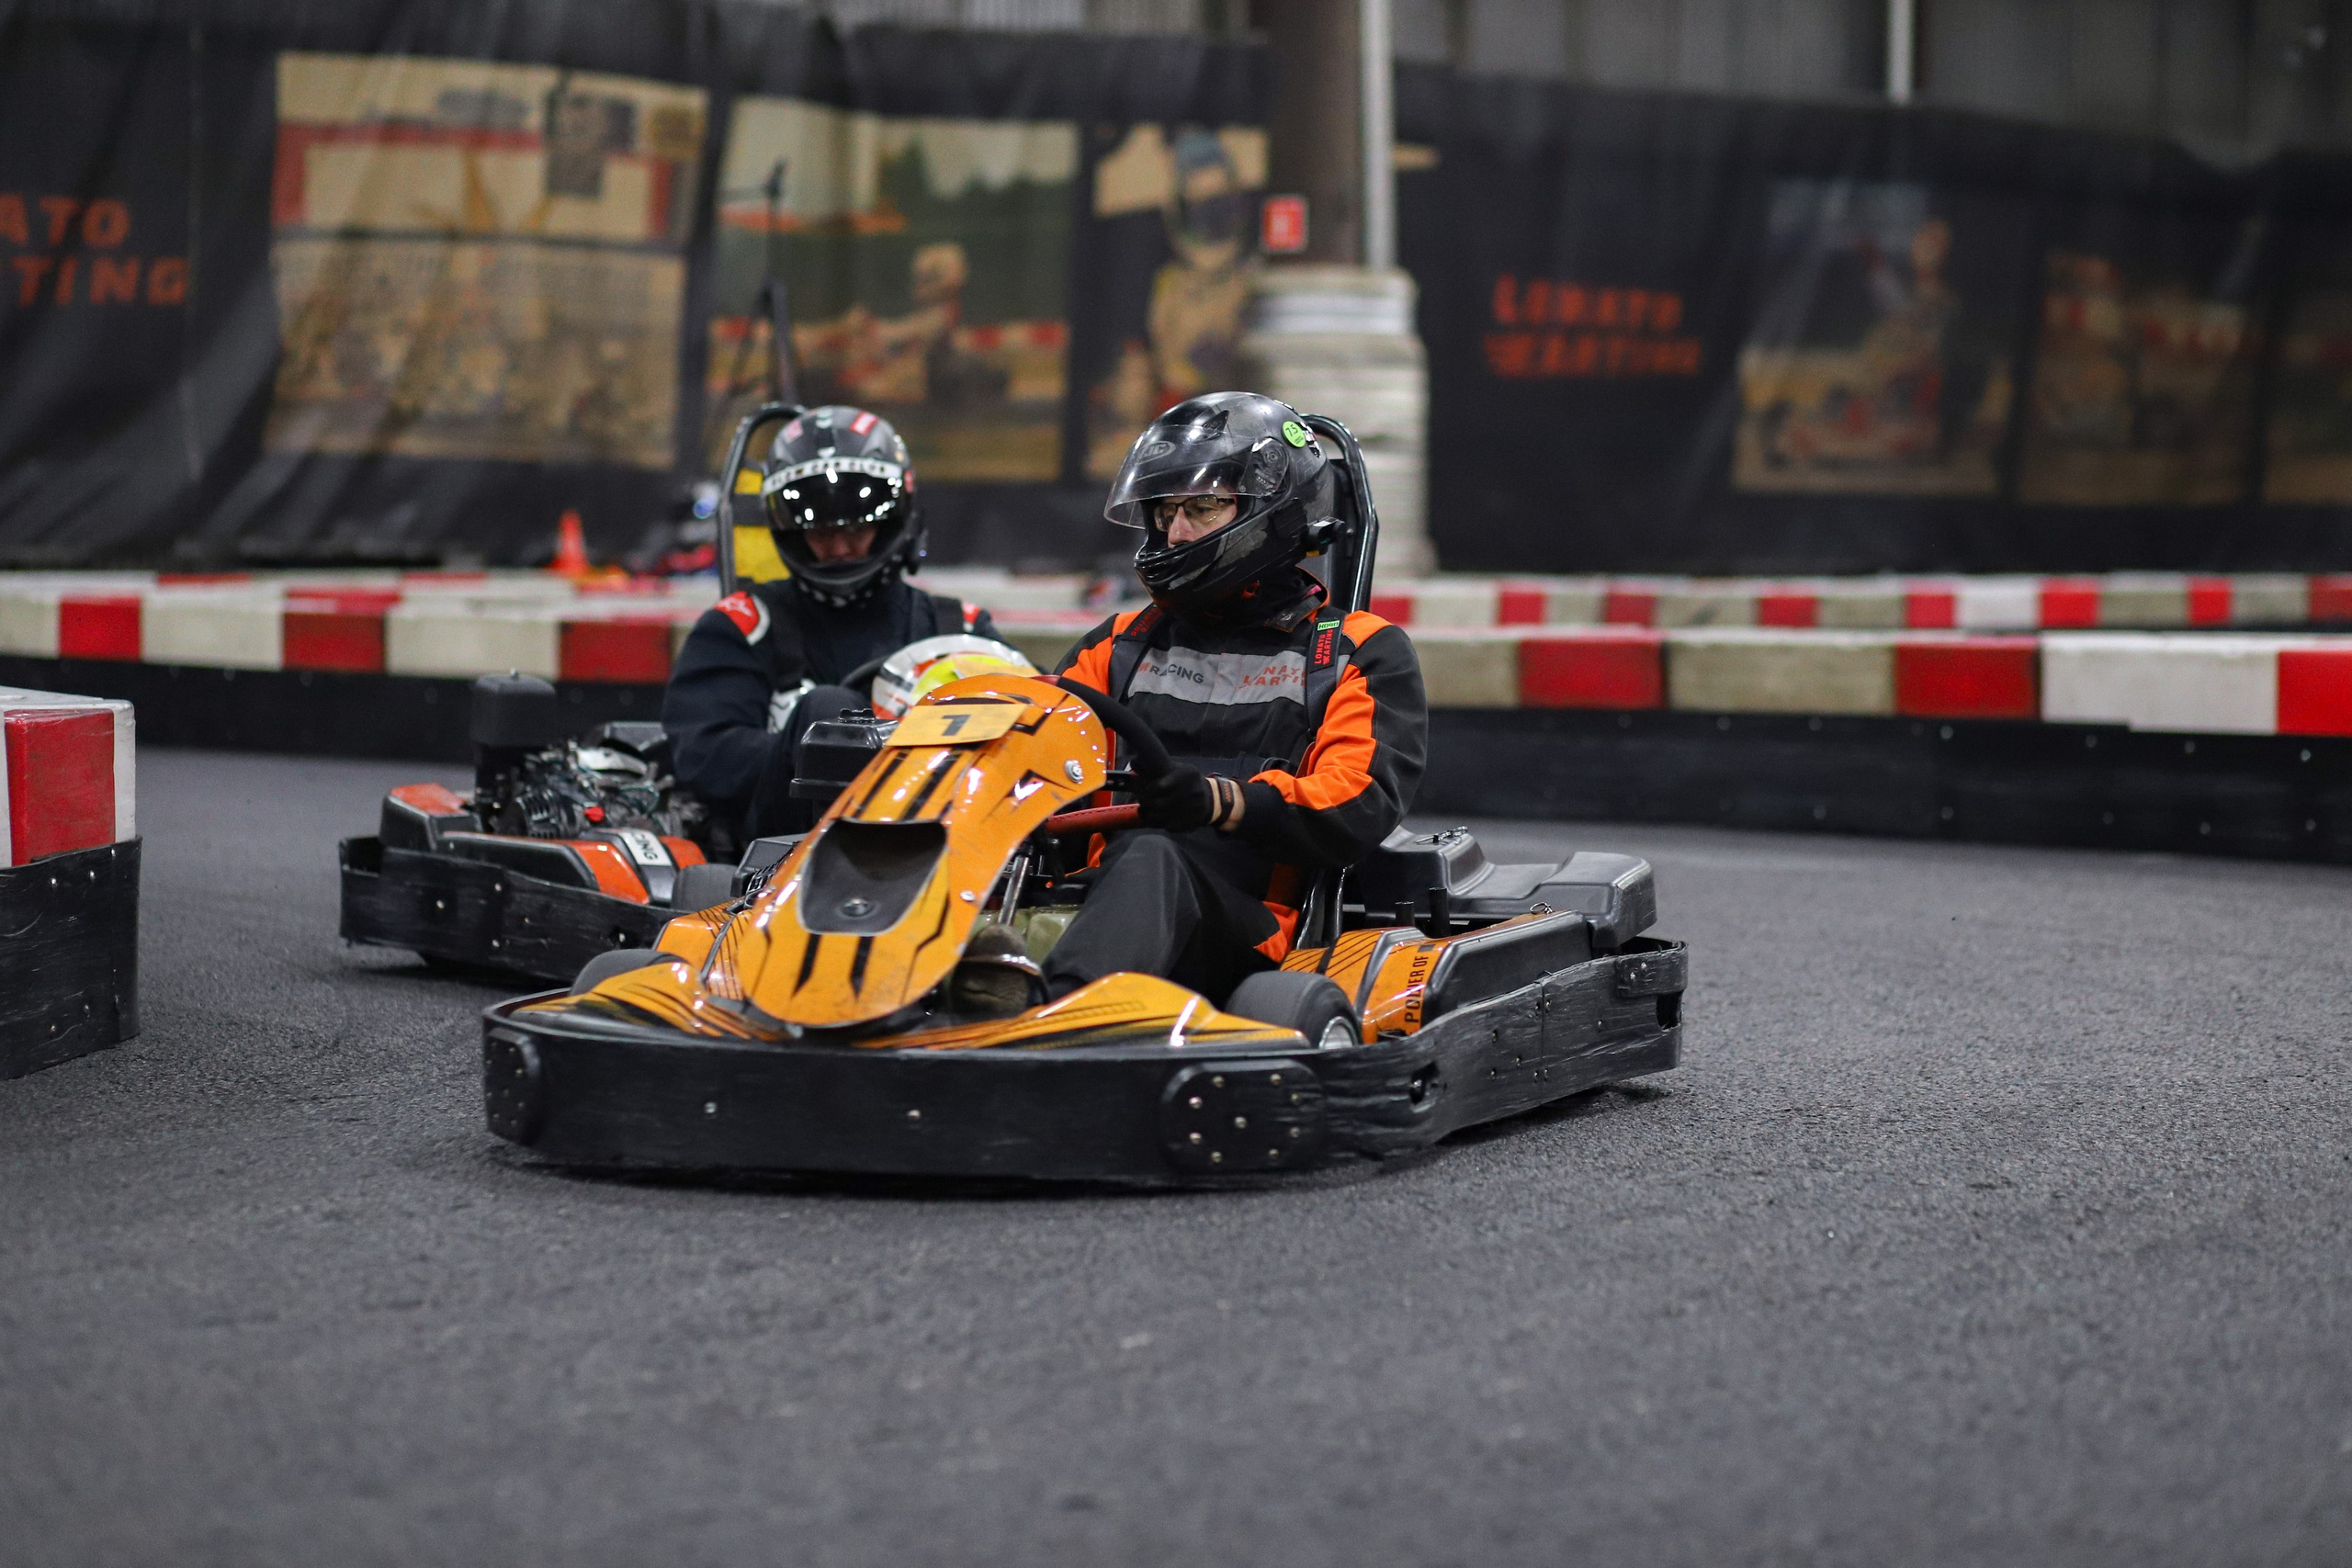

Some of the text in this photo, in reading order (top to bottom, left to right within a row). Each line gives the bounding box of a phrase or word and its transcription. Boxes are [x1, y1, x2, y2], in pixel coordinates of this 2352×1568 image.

[1314, 634, 1326, 664] LONATO
[942, 715, 970, 736] 1
[1412, 956, 1429, 968] OF
